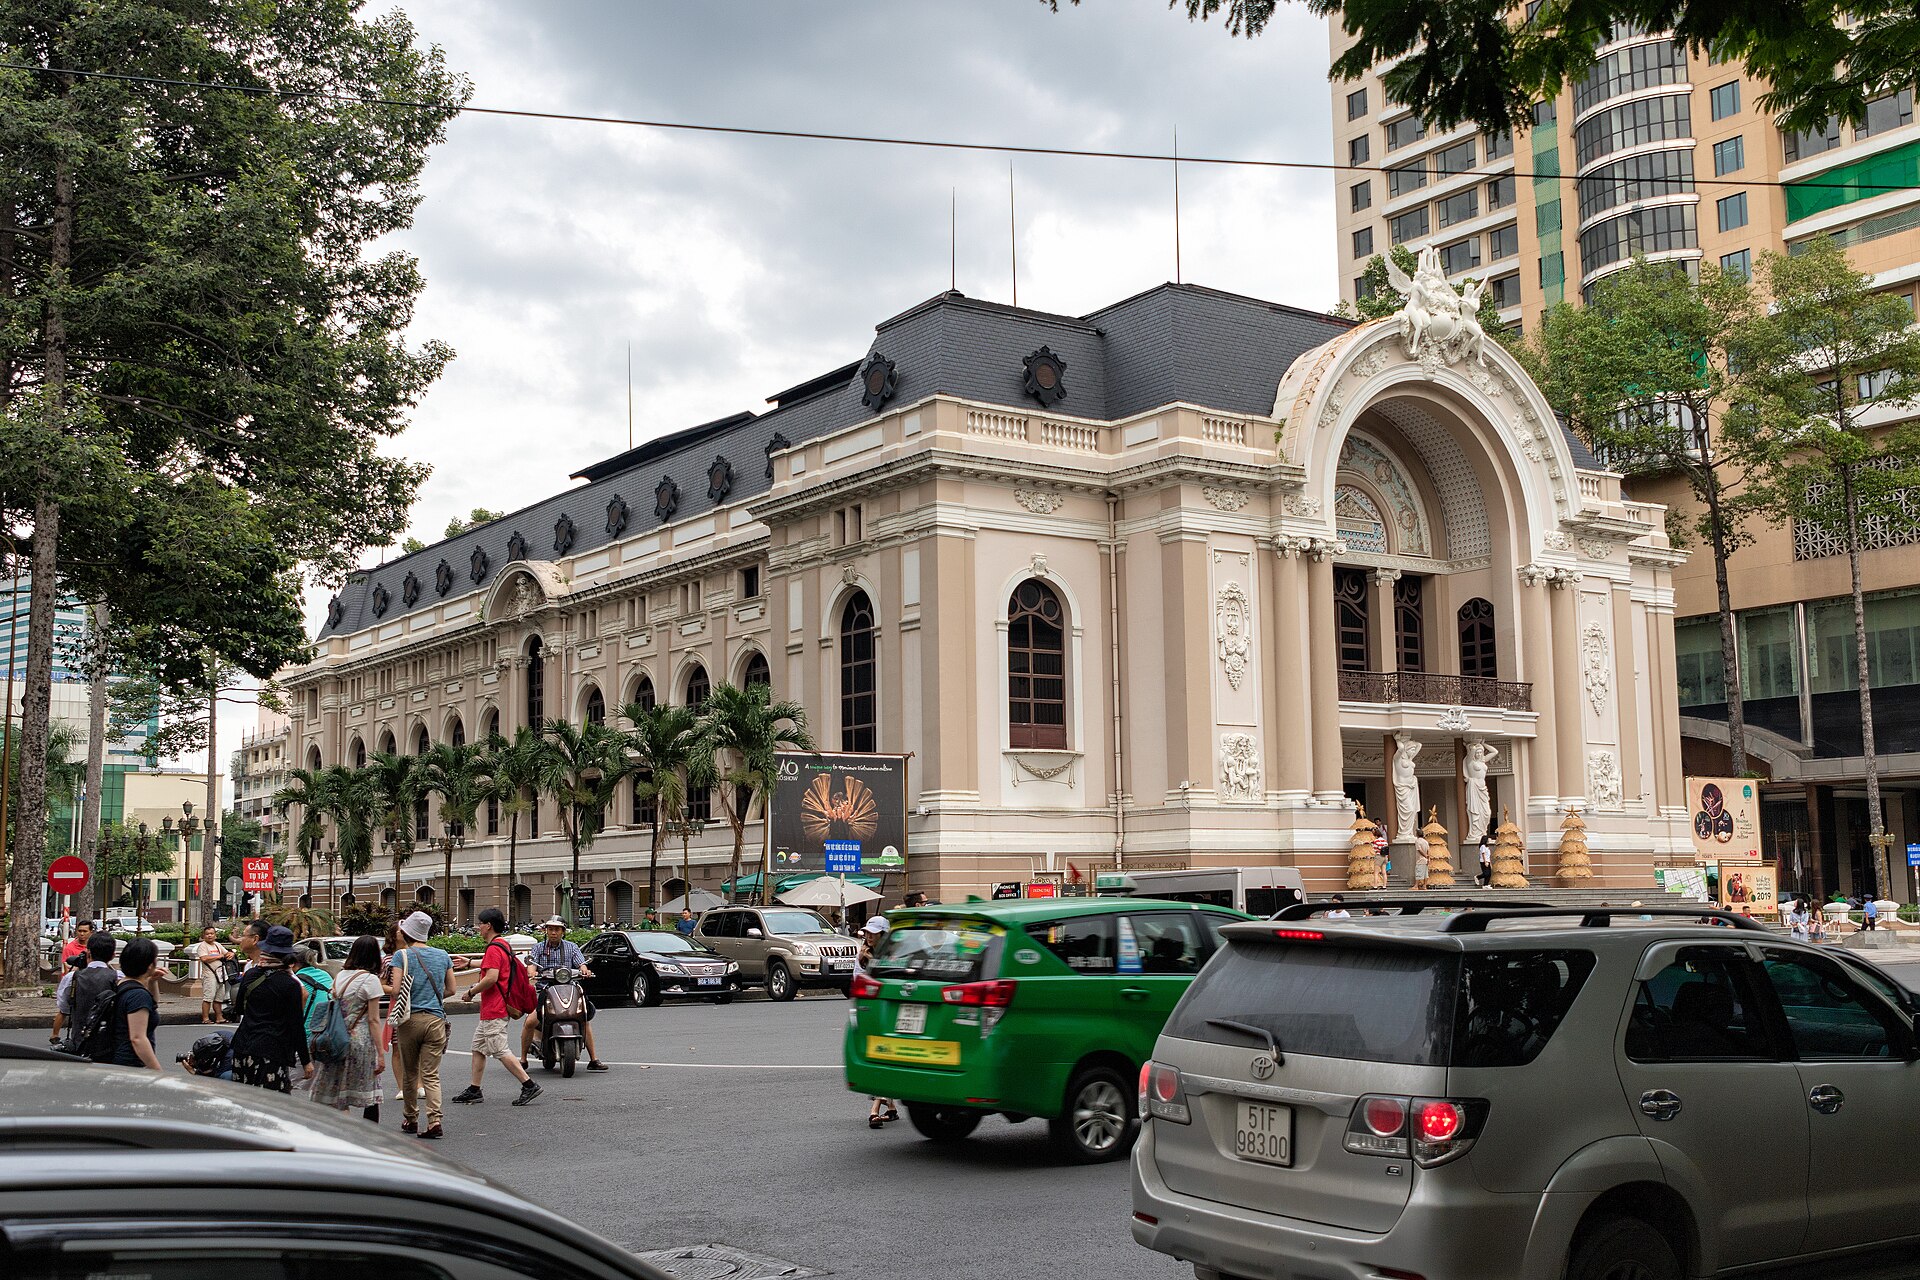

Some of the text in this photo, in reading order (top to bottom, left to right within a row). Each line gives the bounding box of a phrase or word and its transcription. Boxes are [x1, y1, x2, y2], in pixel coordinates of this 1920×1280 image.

[248, 859, 269, 870] CẤM
[1756, 892, 1772, 901] 2019
[1208, 1079, 1316, 1101] FORTUNER
[1248, 1106, 1277, 1132] 51F
[1237, 1129, 1288, 1160] 983.00
